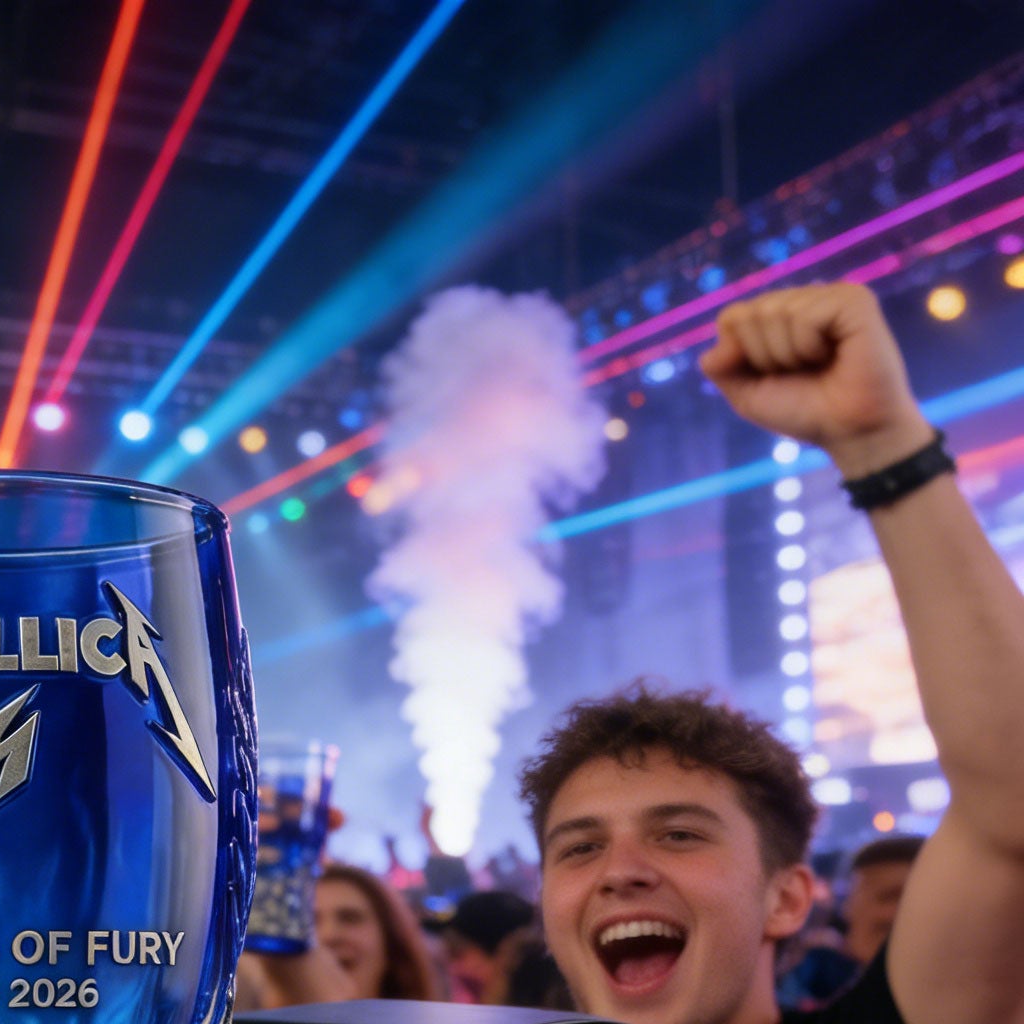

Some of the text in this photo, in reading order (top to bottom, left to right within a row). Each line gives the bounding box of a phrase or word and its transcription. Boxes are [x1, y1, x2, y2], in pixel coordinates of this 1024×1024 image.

[12, 930, 72, 966] OF
[86, 931, 185, 967] FURY
[7, 978, 100, 1010] 2026
